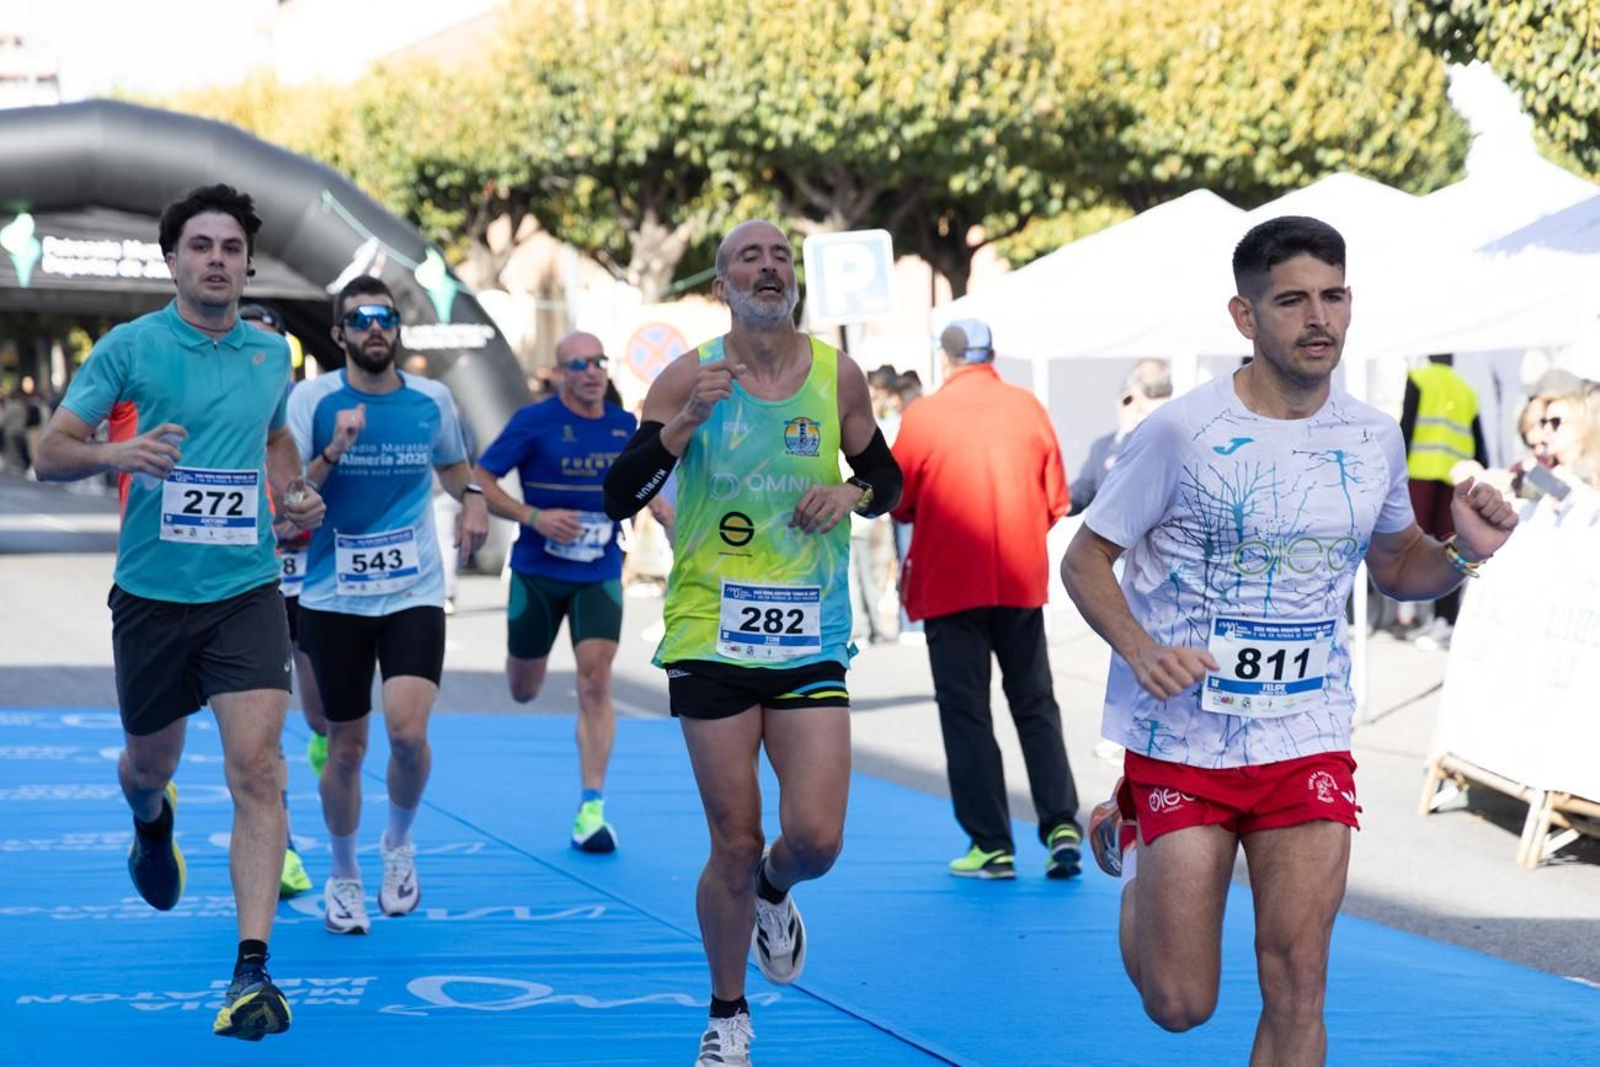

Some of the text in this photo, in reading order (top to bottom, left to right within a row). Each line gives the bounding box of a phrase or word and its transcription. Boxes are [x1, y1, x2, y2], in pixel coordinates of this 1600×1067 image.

[821, 244, 877, 316] P
[396, 453, 428, 465] 2025
[635, 468, 667, 499] KIPRUN
[748, 473, 823, 493] OMNI
[182, 489, 244, 516] 272
[352, 549, 403, 573] 543
[739, 606, 804, 634] 282
[1234, 647, 1310, 681] 811
[16, 987, 365, 1005] MAATÓN
[130, 997, 361, 1011] MDIA
